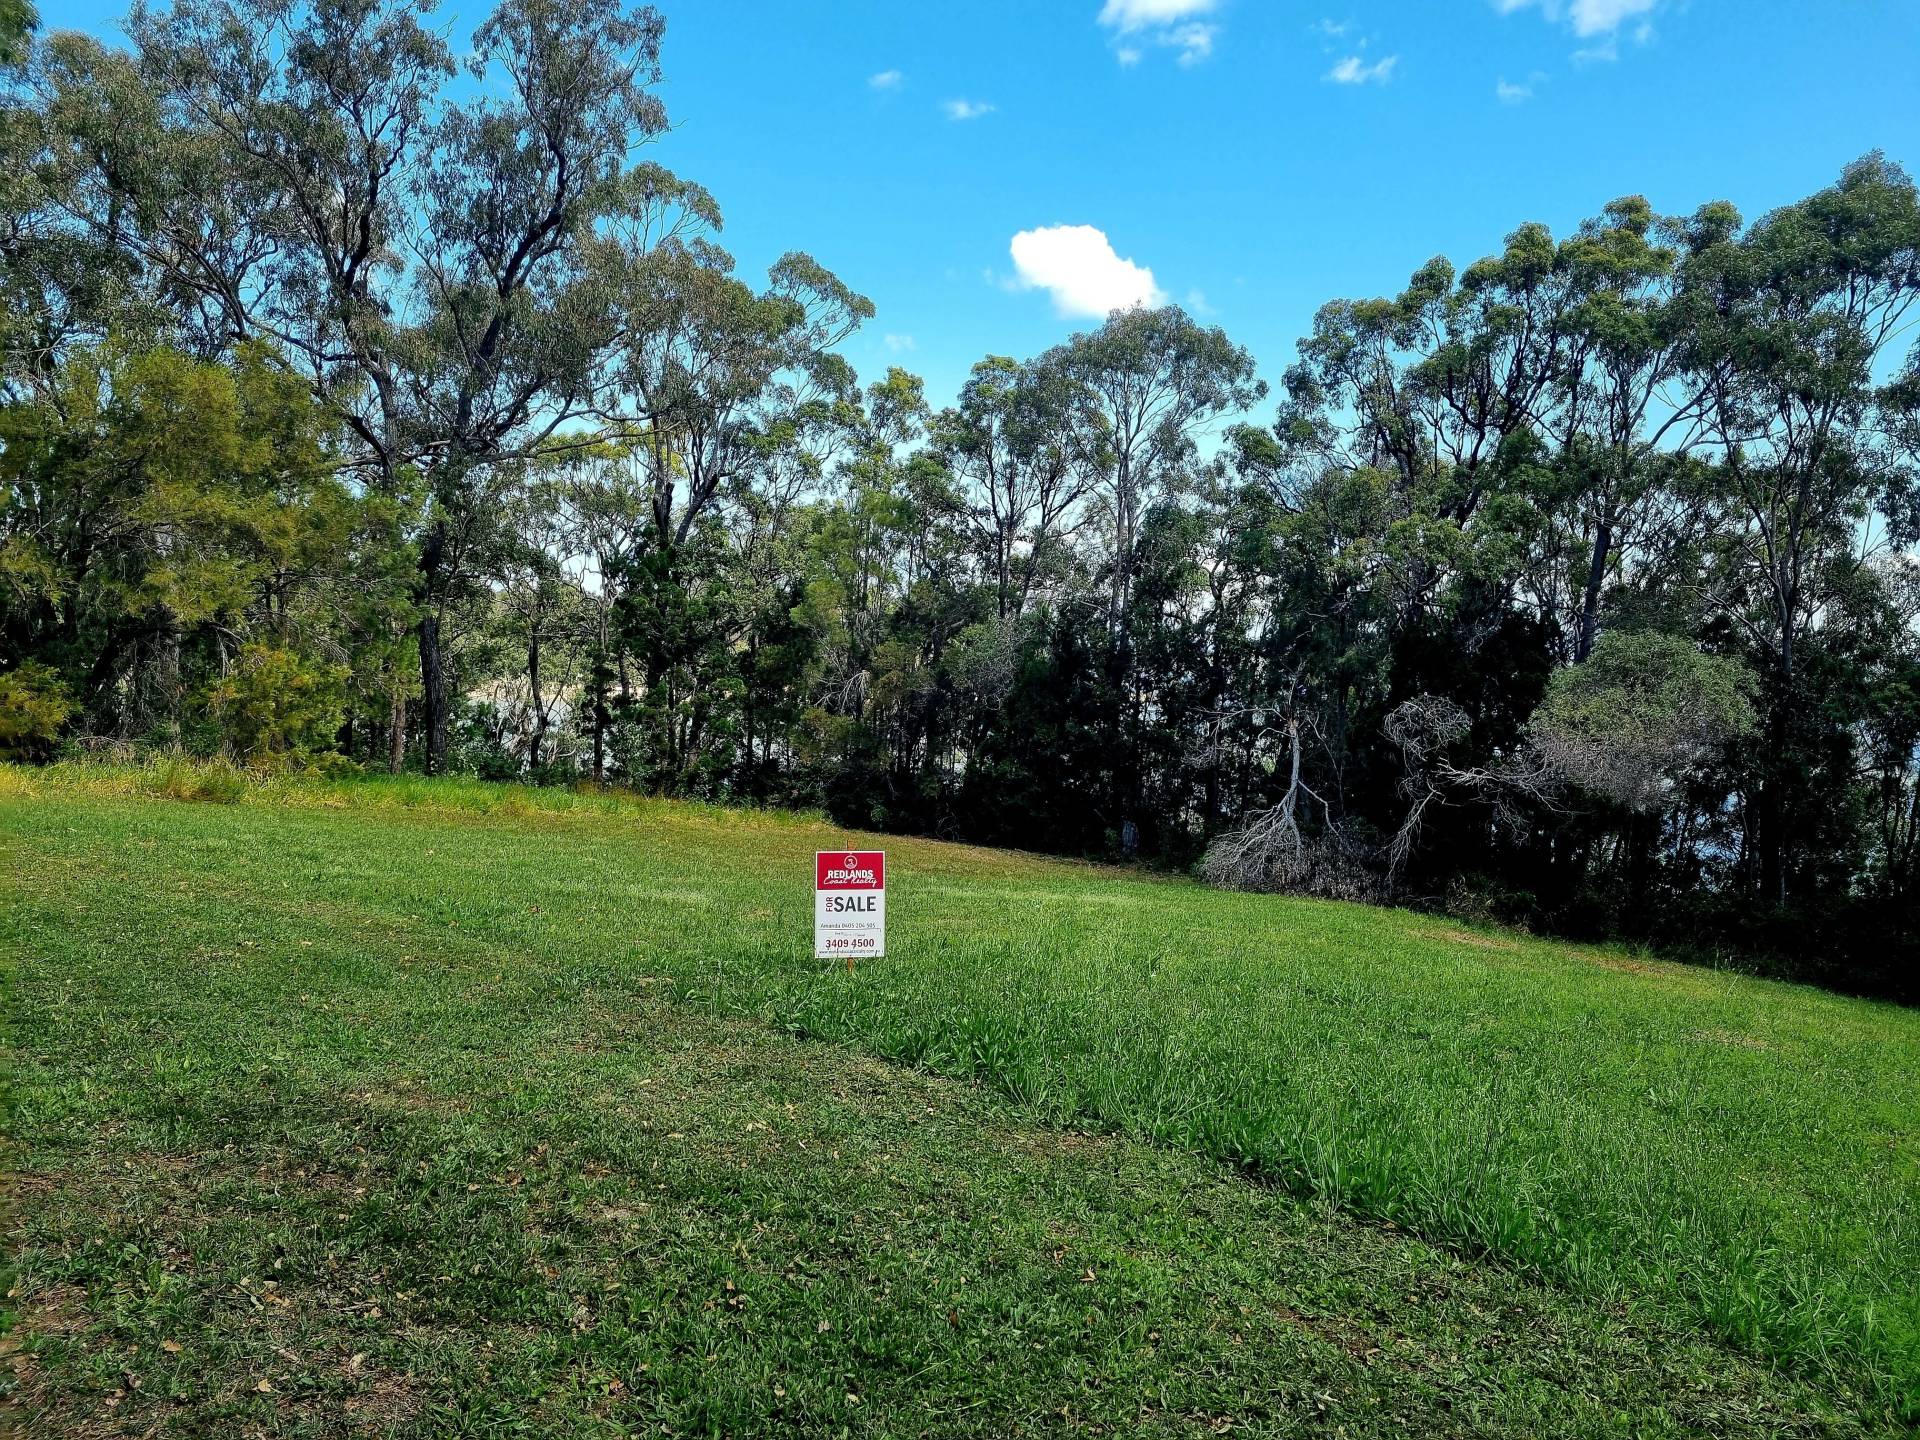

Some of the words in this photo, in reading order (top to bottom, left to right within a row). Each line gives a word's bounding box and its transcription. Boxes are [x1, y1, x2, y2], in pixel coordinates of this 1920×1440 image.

[828, 870, 873, 878] REDLANDS
[824, 877, 848, 885] Coast
[850, 877, 877, 887] Realty
[834, 896, 876, 912] SALE
[826, 939, 848, 948] 3409
[851, 939, 874, 948] 4500
